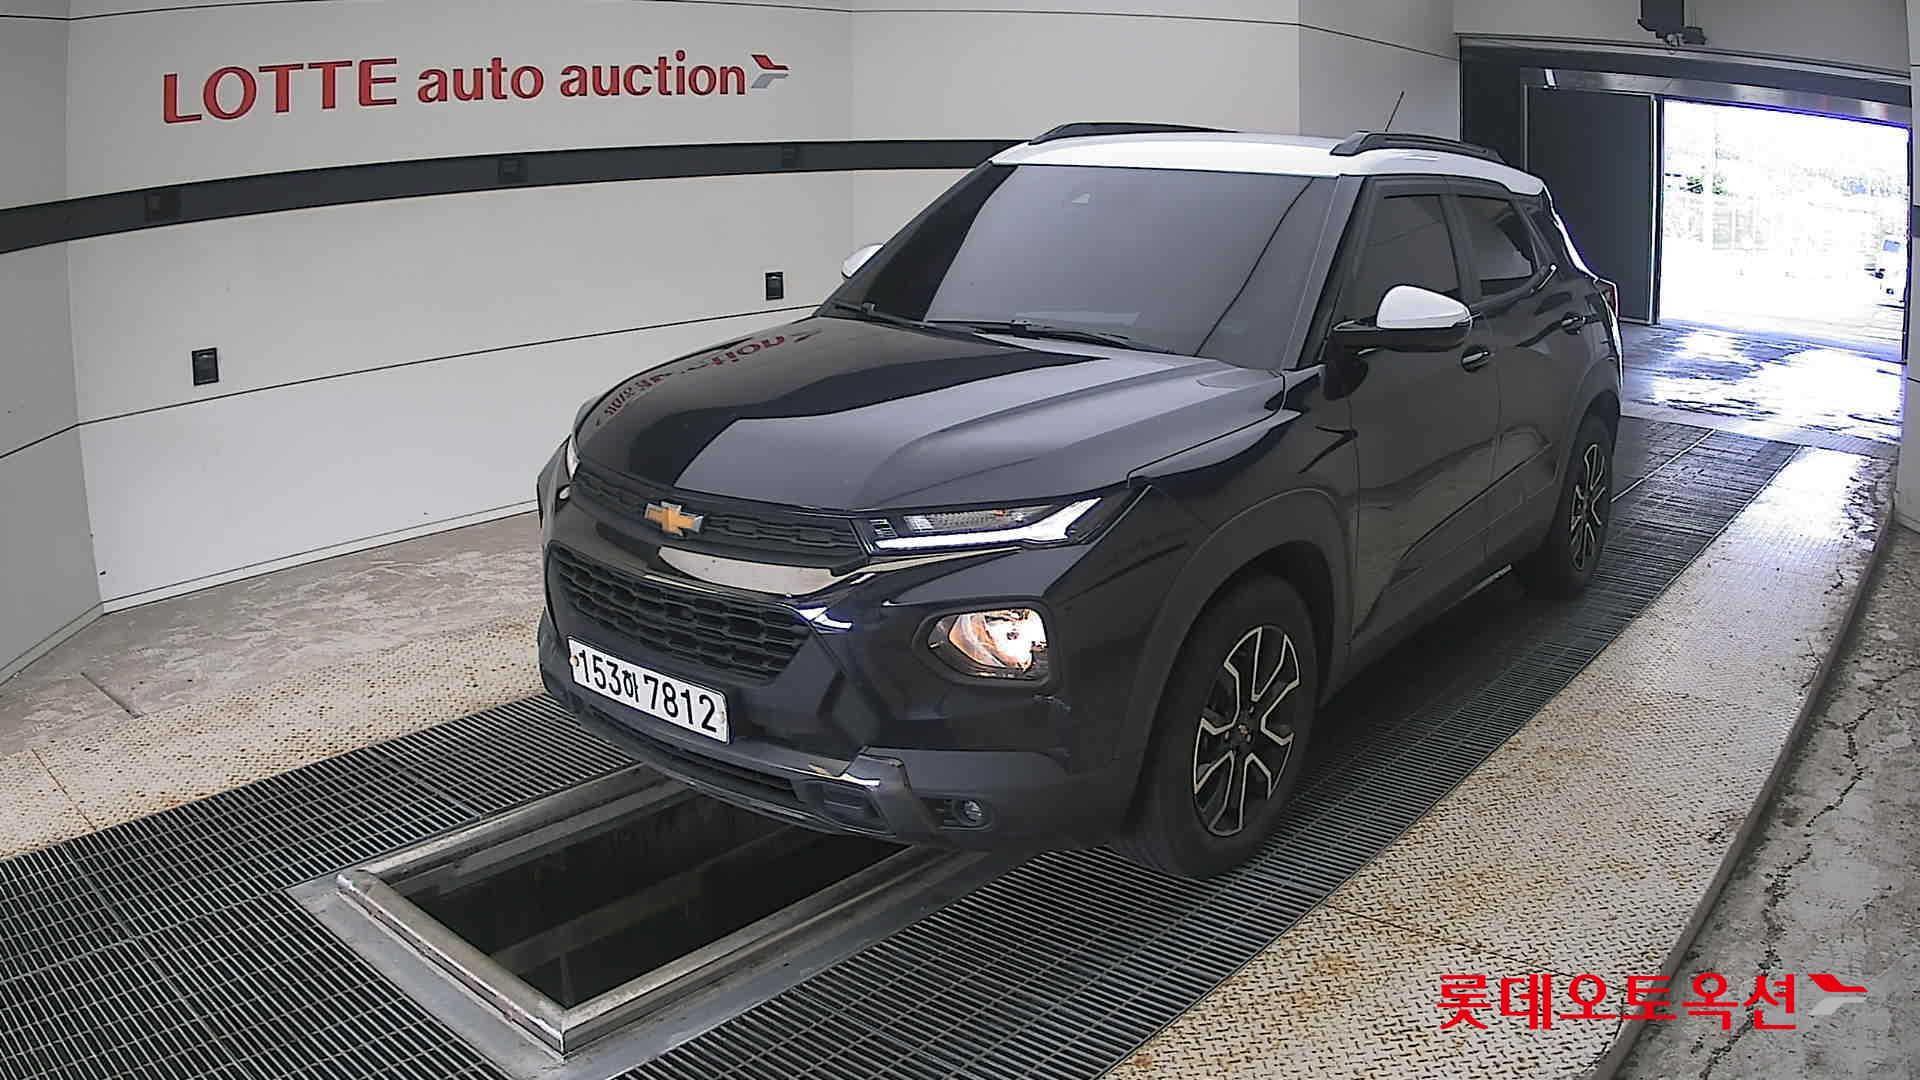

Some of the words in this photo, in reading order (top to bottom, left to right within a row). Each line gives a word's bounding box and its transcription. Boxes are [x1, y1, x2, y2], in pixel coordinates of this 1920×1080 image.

[162, 58, 398, 125] LOTTE
[416, 56, 545, 103] auto
[559, 50, 747, 97] auction
